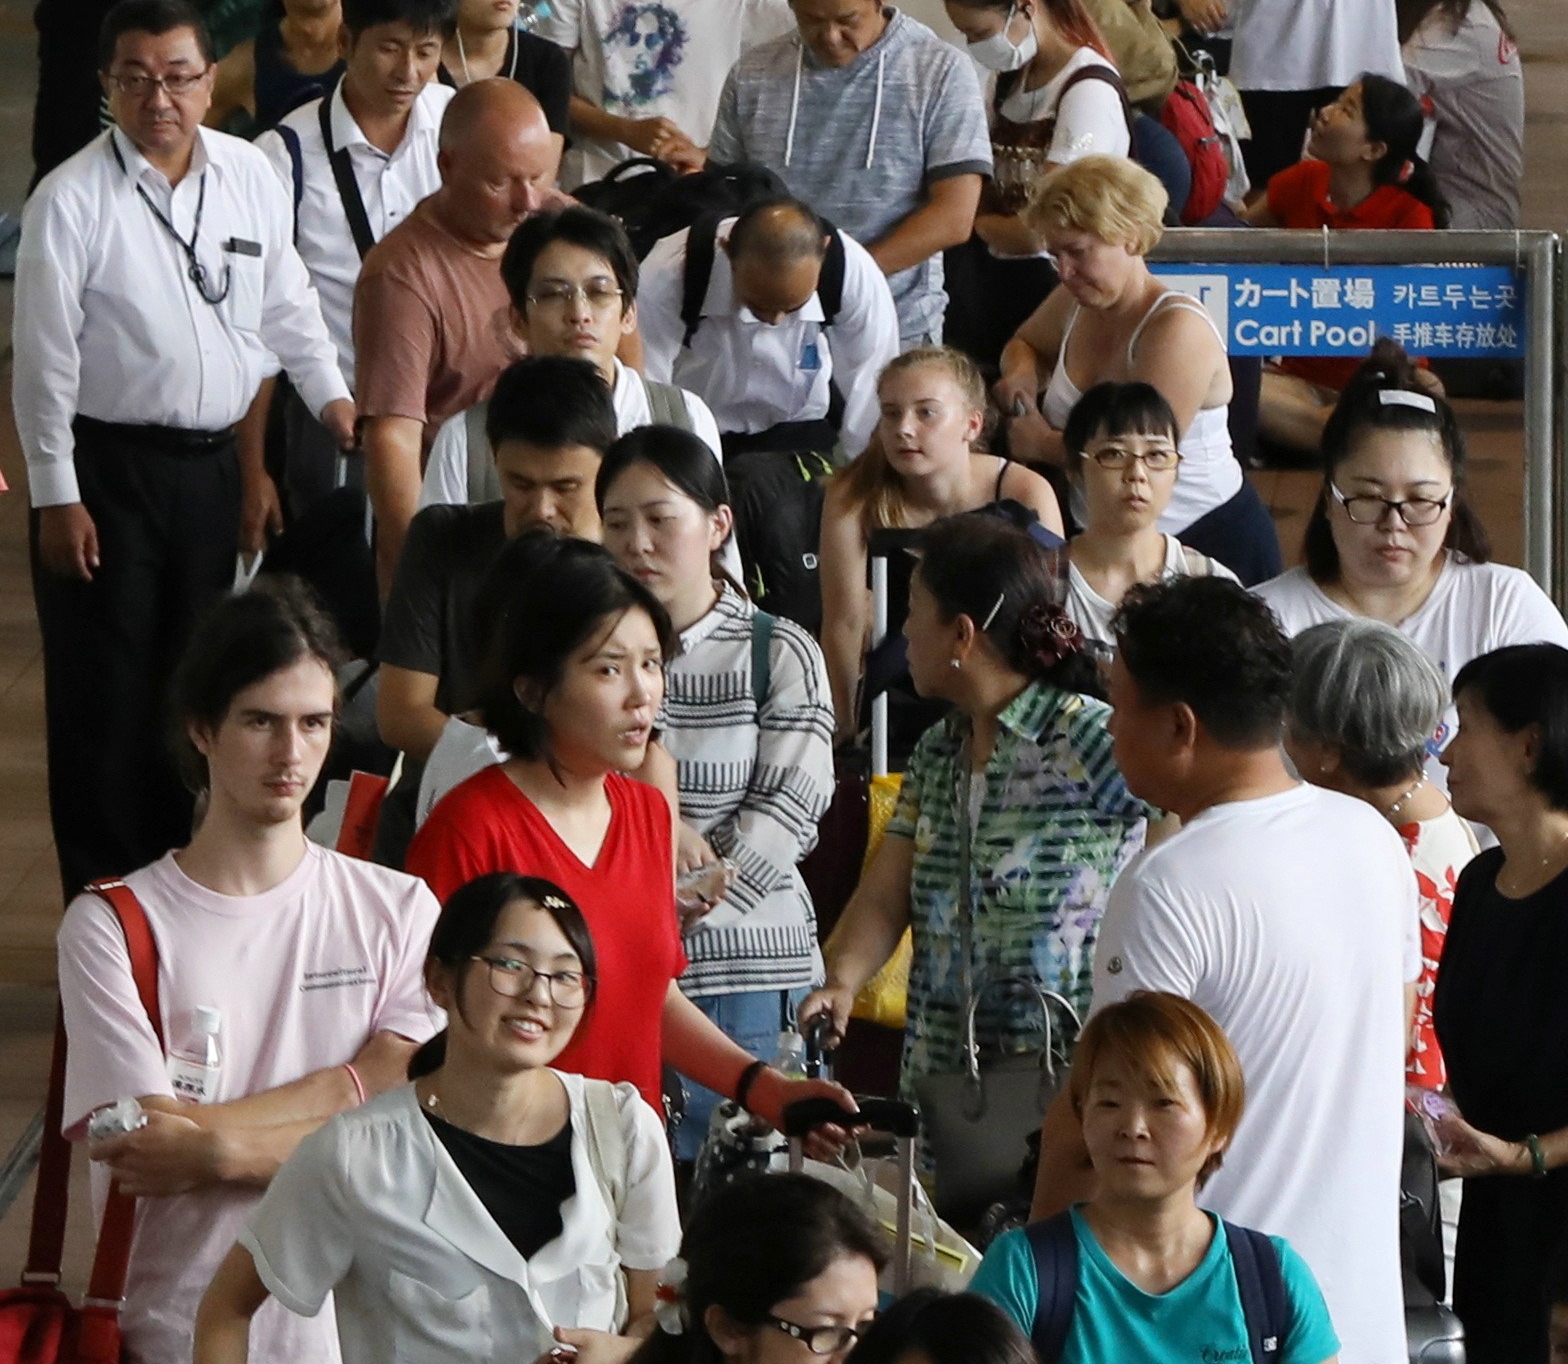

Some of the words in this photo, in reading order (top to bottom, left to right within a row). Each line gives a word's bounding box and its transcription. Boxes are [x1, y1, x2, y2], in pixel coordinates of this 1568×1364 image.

[1234, 278, 1375, 310] カート置場
[1393, 283, 1518, 310] 카트두는곳
[1235, 320, 1302, 348] Cart
[1310, 319, 1375, 348] Pool
[1391, 322, 1518, 349] 手推车存放处
